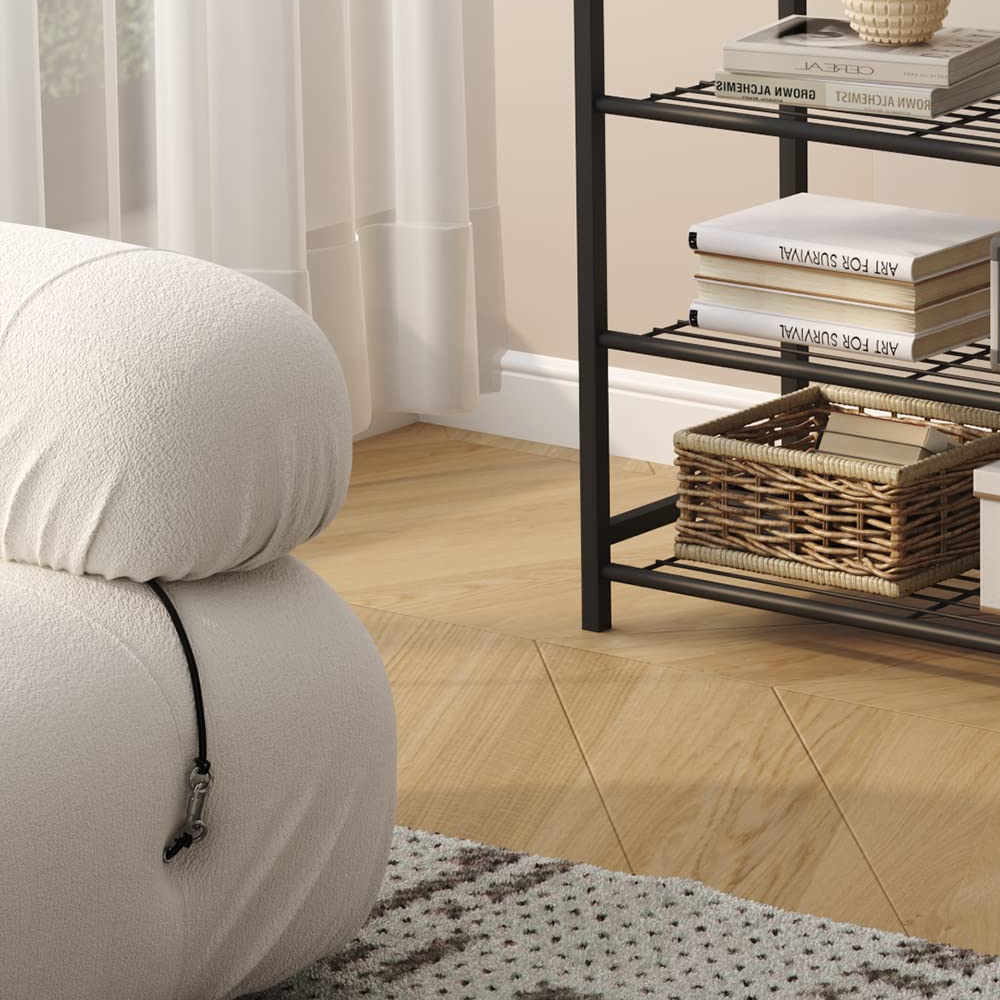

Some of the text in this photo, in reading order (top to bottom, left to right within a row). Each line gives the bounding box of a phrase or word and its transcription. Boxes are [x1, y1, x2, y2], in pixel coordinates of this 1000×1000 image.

[778, 245, 899, 277] ART FOR SURVIVAL
[779, 323, 899, 356] ART FOR SURVIVAL
